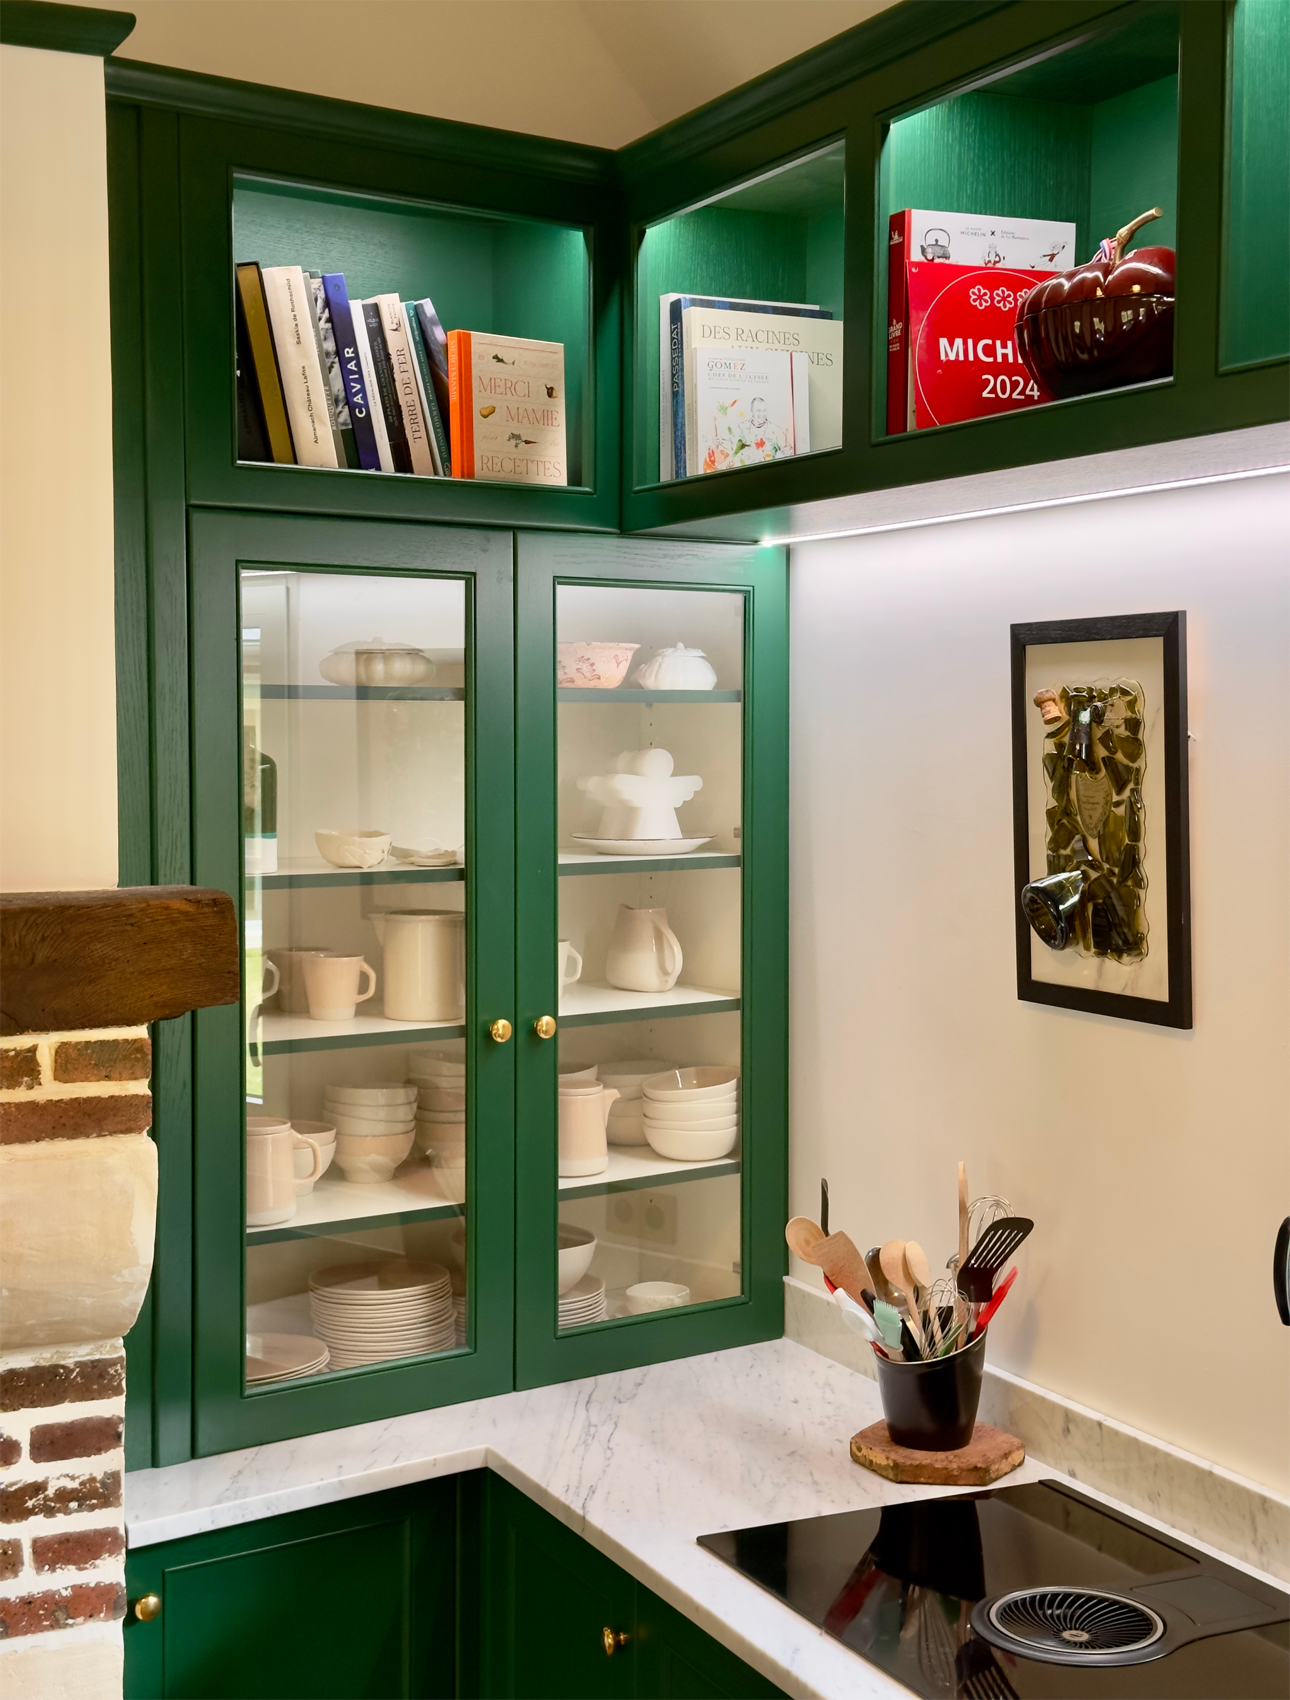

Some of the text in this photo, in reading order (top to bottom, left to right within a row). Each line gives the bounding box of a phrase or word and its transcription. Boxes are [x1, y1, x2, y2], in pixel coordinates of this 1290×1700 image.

[286, 278, 302, 345] Saskia de Rothschild
[701, 324, 731, 340] DES
[735, 327, 800, 347] RACINES
[671, 324, 680, 392] PASSEDAT
[707, 360, 746, 371] GOMEZ
[345, 347, 366, 418] CAVIAR
[396, 348, 422, 444] TERRE DE FER
[478, 376, 530, 398] MERCI
[982, 374, 1040, 400] 2024
[306, 384, 314, 412] Château
[309, 412, 319, 444] Almanach
[506, 405, 560, 428] MAMIE
[480, 454, 562, 479] RECETTES
